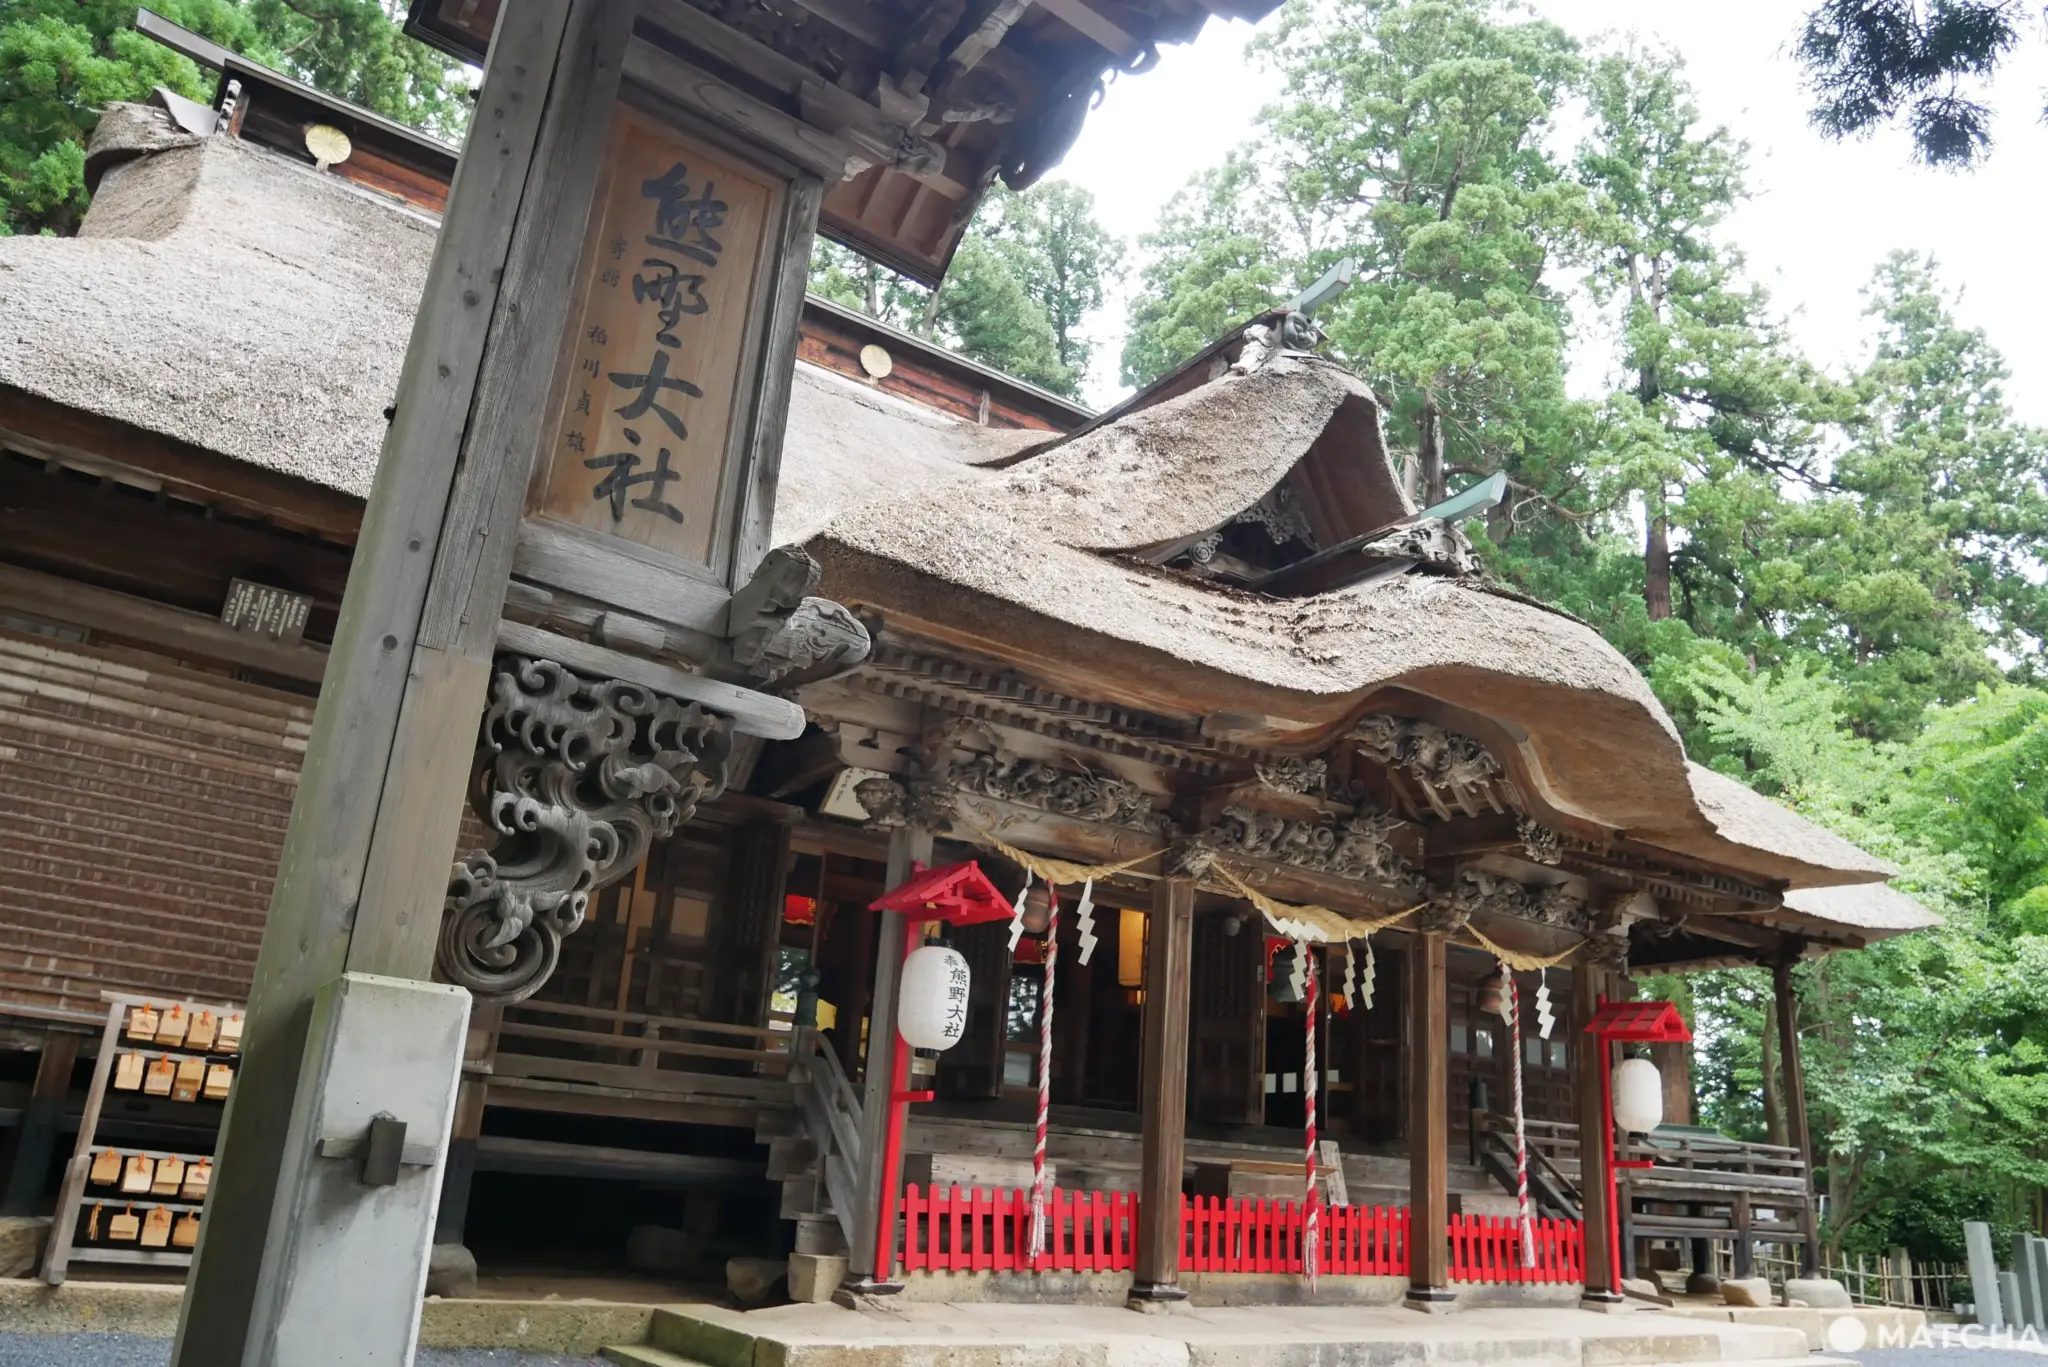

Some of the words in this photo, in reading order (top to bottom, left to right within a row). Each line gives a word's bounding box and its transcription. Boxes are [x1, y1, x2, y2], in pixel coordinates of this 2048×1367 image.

[584, 161, 729, 524] 熊野大社
[941, 968, 967, 1038] 熊野大社
